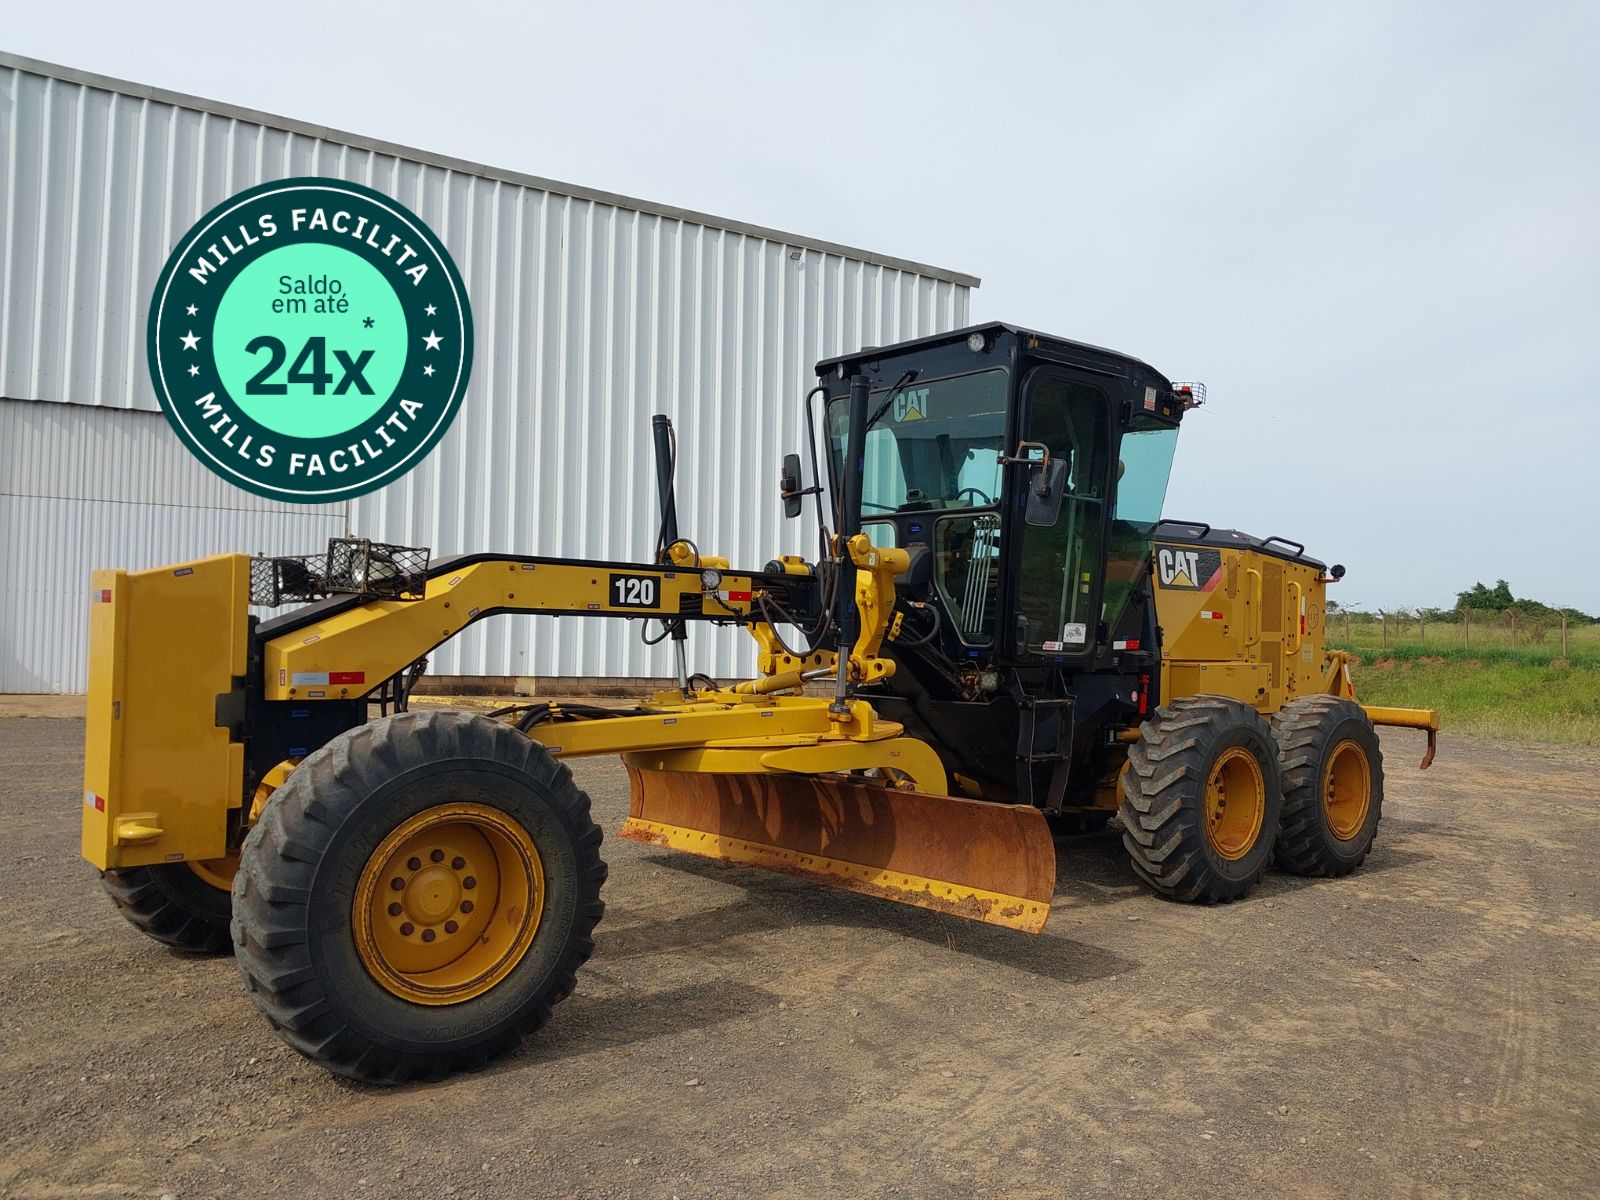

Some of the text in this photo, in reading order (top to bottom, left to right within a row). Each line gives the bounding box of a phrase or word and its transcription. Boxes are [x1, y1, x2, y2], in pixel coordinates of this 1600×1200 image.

[893, 388, 930, 423] CAT
[1159, 549, 1199, 587] CAT
[615, 578, 654, 605] 120
